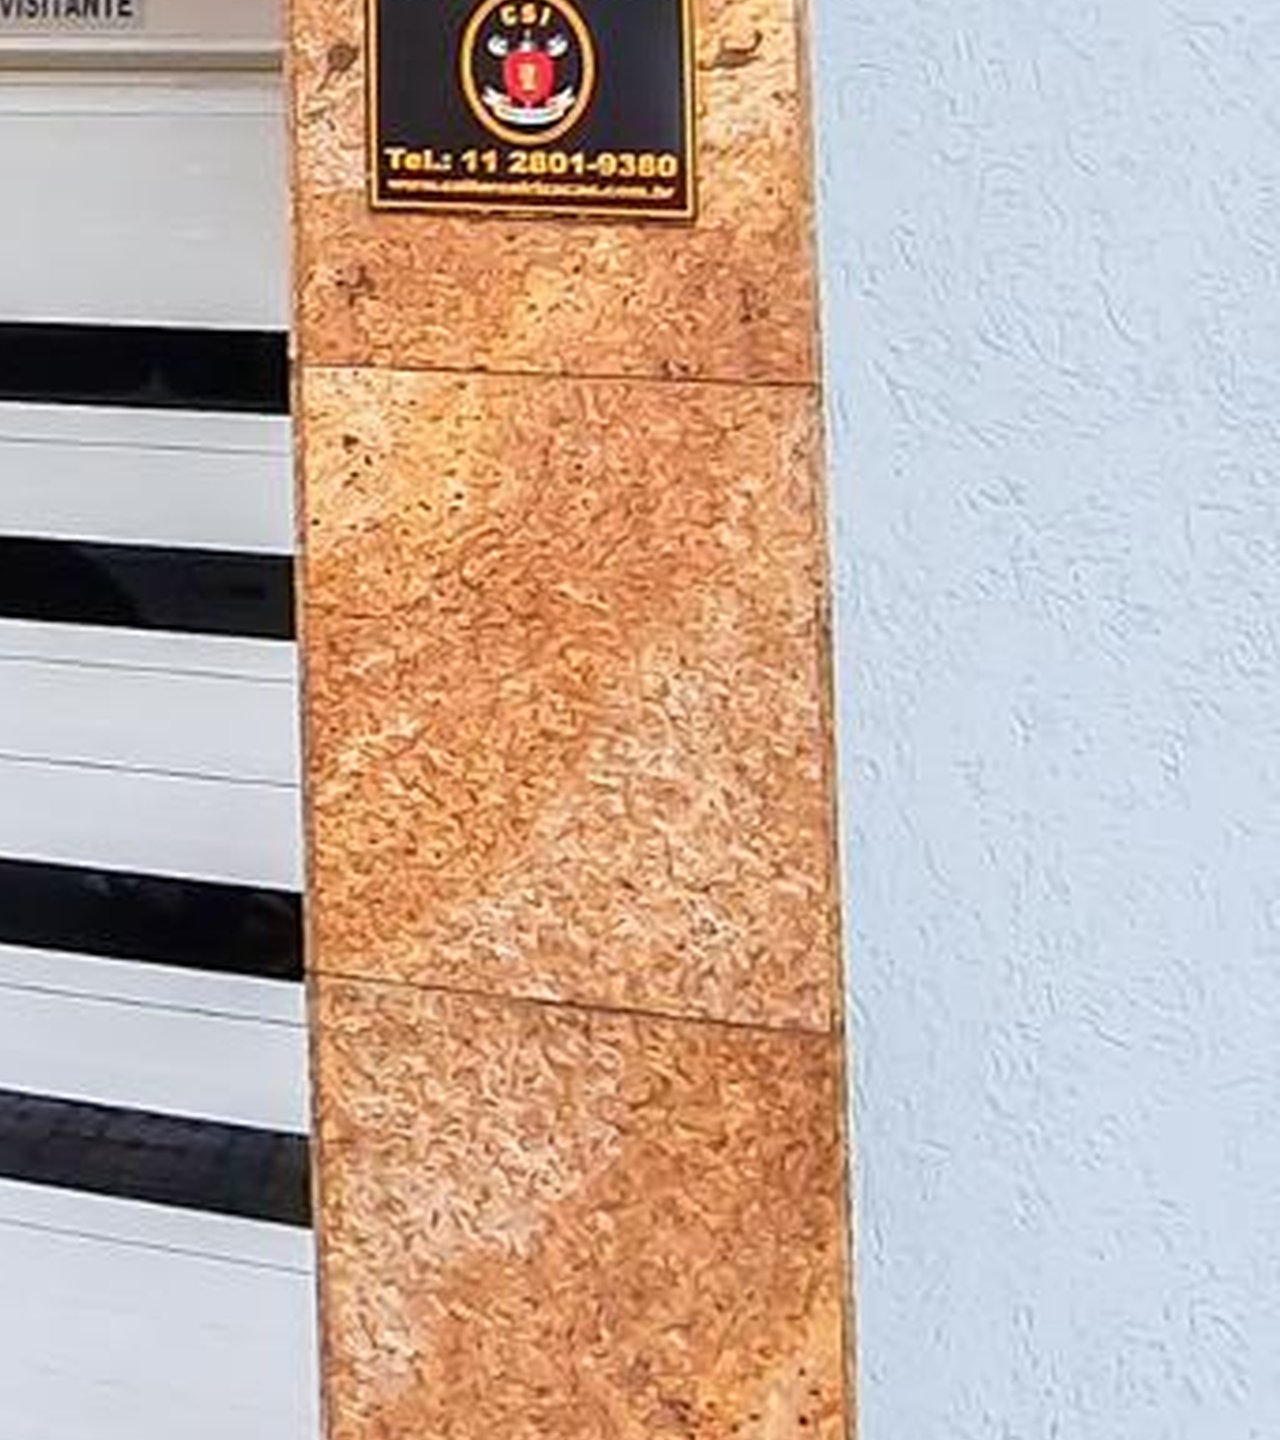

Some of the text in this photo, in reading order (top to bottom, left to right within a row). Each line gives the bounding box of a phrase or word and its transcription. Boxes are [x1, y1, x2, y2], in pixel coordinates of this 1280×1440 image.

[500, 2, 552, 27] CSI
[461, 149, 497, 173] 11
[507, 150, 678, 178] 2801-9380
